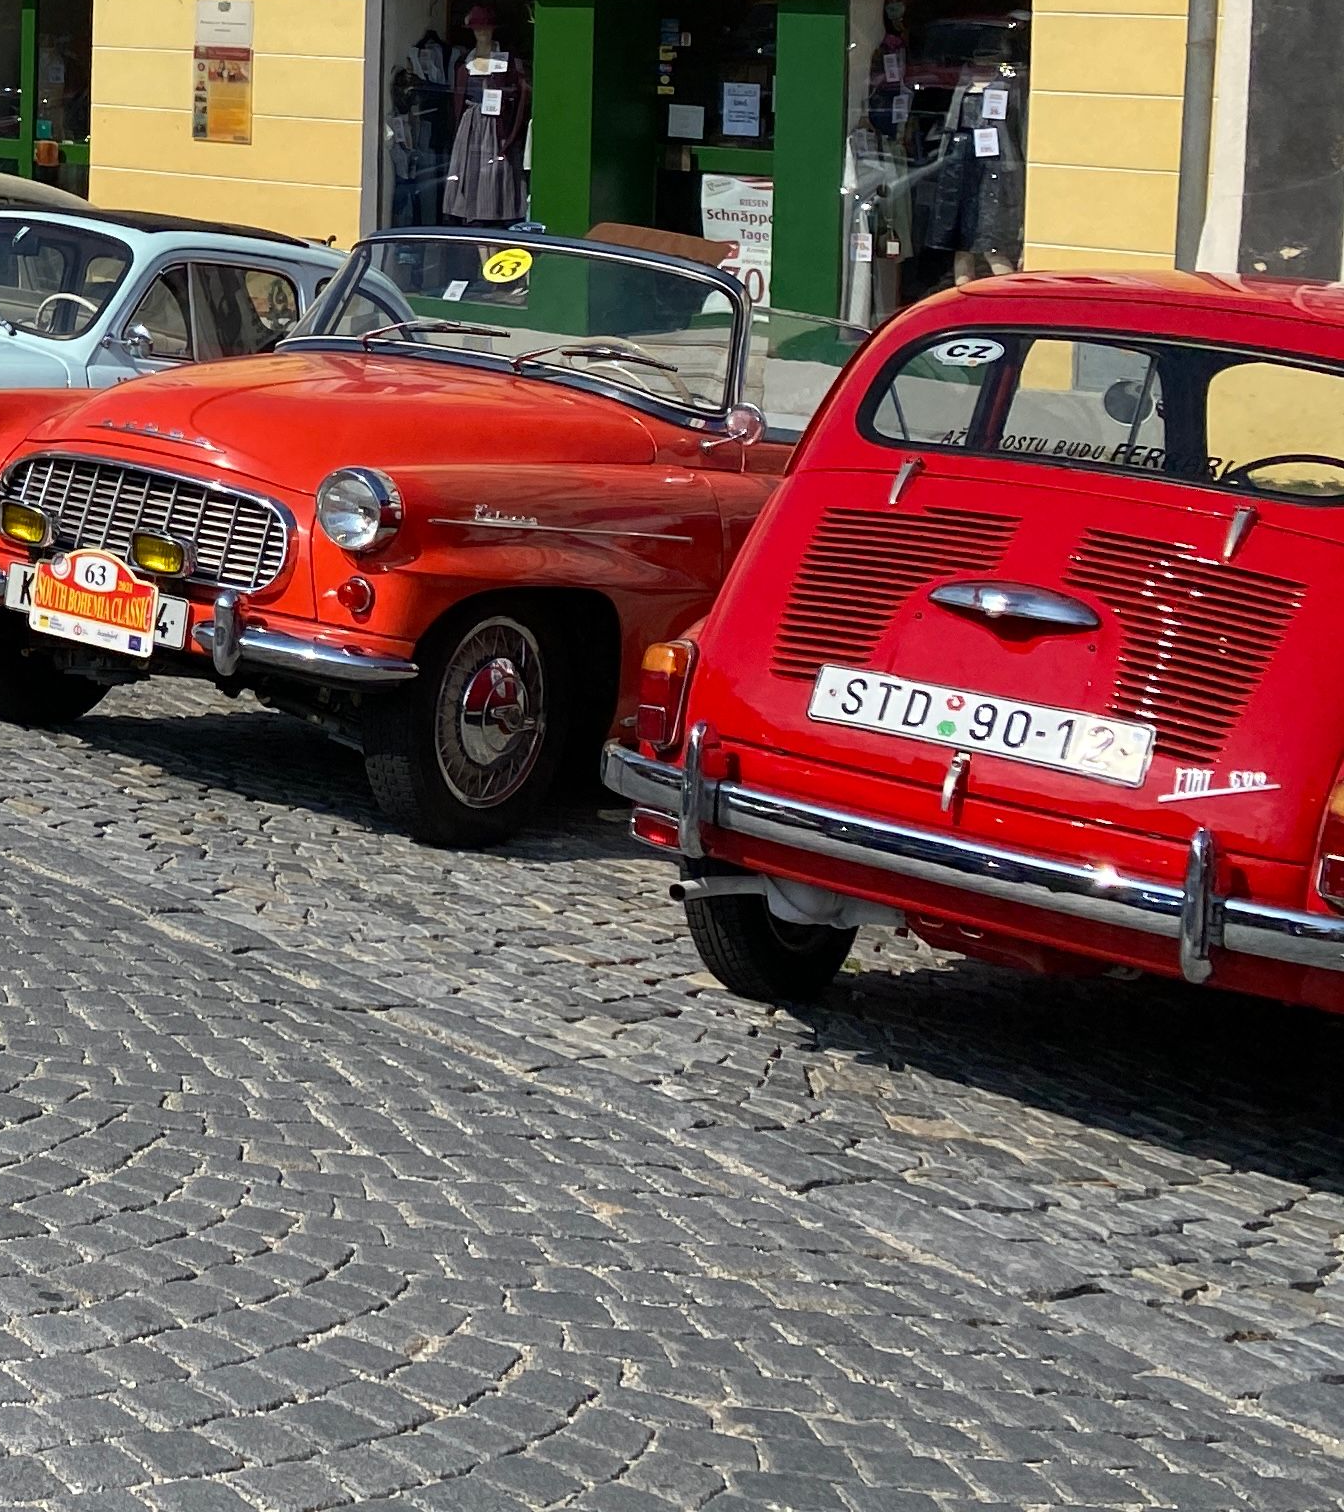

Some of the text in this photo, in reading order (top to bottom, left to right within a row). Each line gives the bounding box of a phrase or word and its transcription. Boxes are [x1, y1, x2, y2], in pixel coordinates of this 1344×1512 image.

[740, 229, 769, 244] Tage
[490, 260, 522, 277] 63
[945, 343, 994, 359] CZ
[1053, 440, 1106, 460] BUDU
[85, 563, 107, 586] 63
[20, 570, 35, 606] K
[36, 573, 154, 633] SOUTH BOHEMIA CLASSIC
[841, 678, 933, 728] STD
[1173, 767, 1215, 794] FIAT
